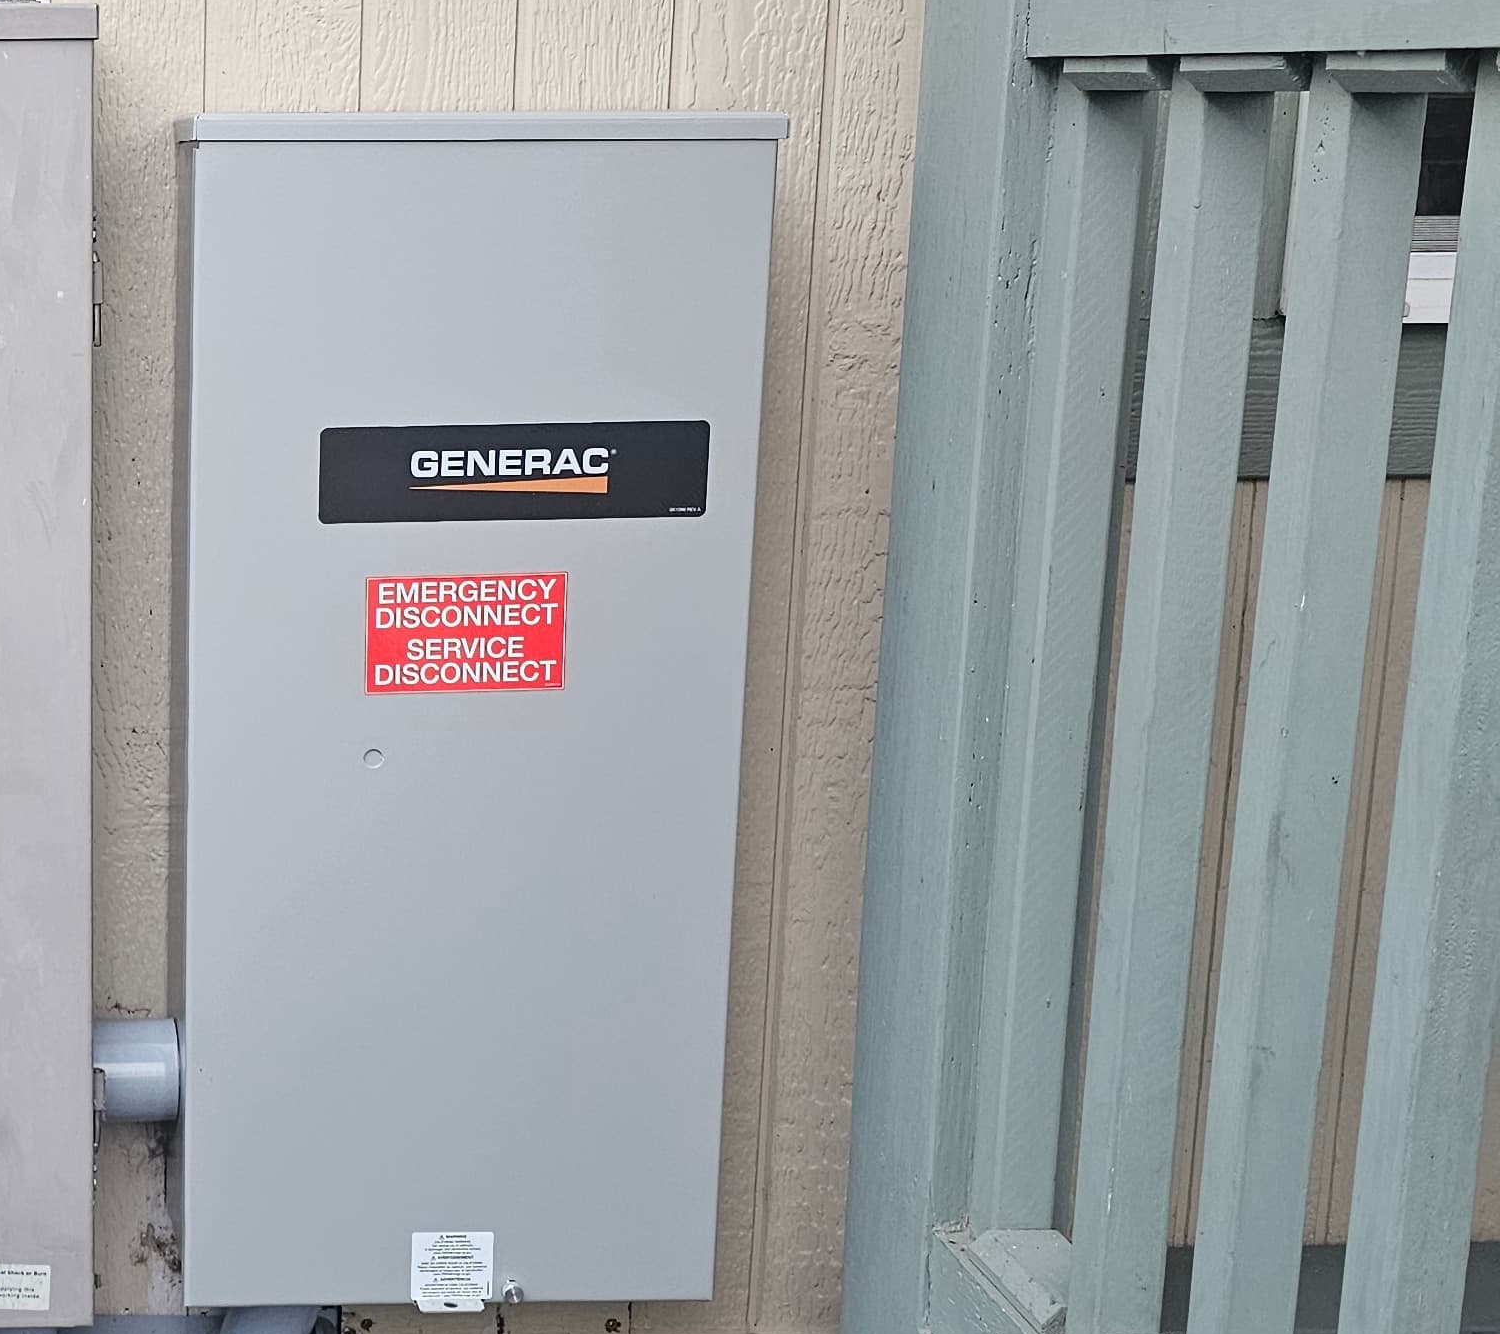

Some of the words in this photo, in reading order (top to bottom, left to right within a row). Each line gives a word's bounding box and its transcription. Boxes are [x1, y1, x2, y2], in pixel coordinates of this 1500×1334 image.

[410, 447, 609, 478] GENERAC
[377, 578, 557, 605] EMERGENCY
[375, 602, 558, 629] DISCONNECT
[406, 636, 525, 661] SERVICE
[374, 660, 557, 687] DISCONNECT
